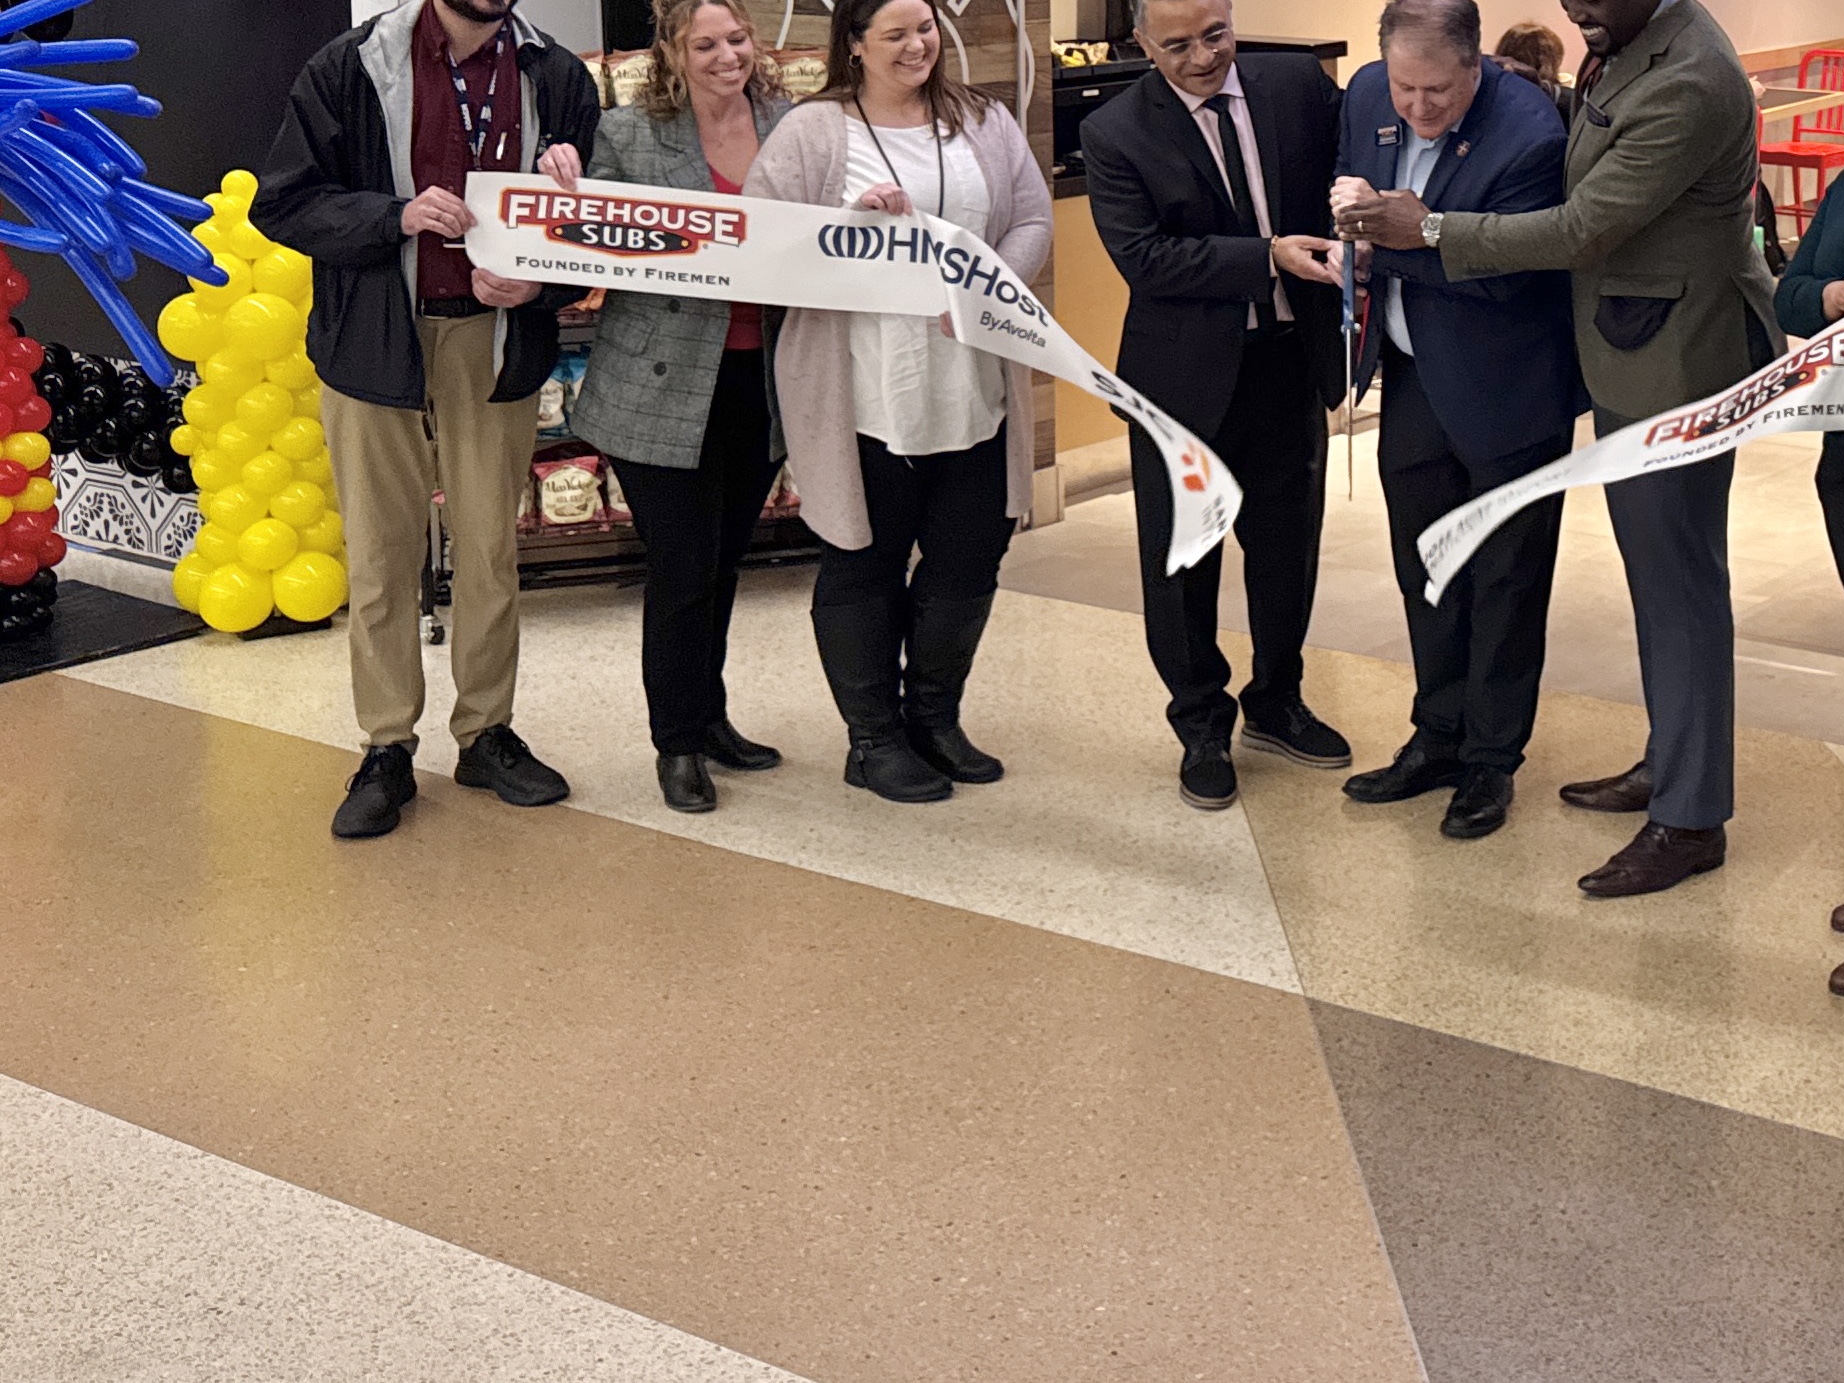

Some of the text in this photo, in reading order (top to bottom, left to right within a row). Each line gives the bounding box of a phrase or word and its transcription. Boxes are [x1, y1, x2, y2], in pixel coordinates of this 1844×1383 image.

[506, 193, 741, 247] FIREHOUSE
[581, 224, 666, 251] SUBS
[1716, 379, 1787, 431] SUBS
